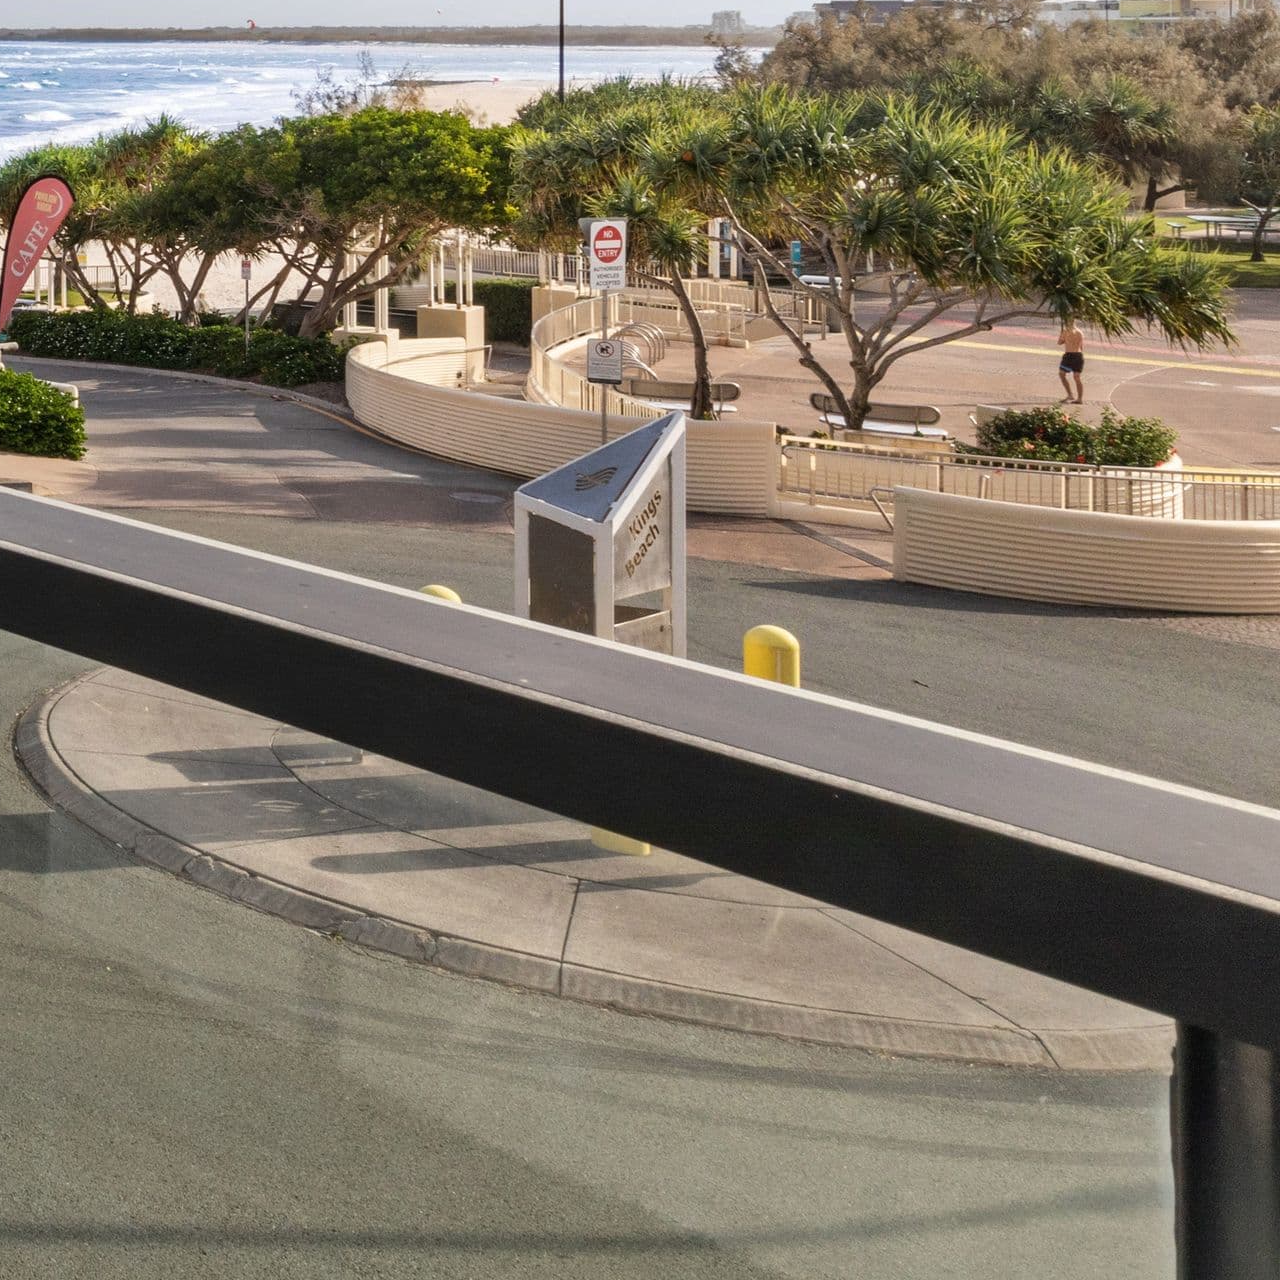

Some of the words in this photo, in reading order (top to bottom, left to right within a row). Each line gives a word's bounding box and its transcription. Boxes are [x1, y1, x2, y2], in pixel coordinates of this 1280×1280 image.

[11, 220, 49, 278] CAFE
[598, 249, 618, 258] ENTRY
[603, 230, 614, 239] NO
[628, 489, 662, 541] Kings
[624, 523, 660, 579] Beach
